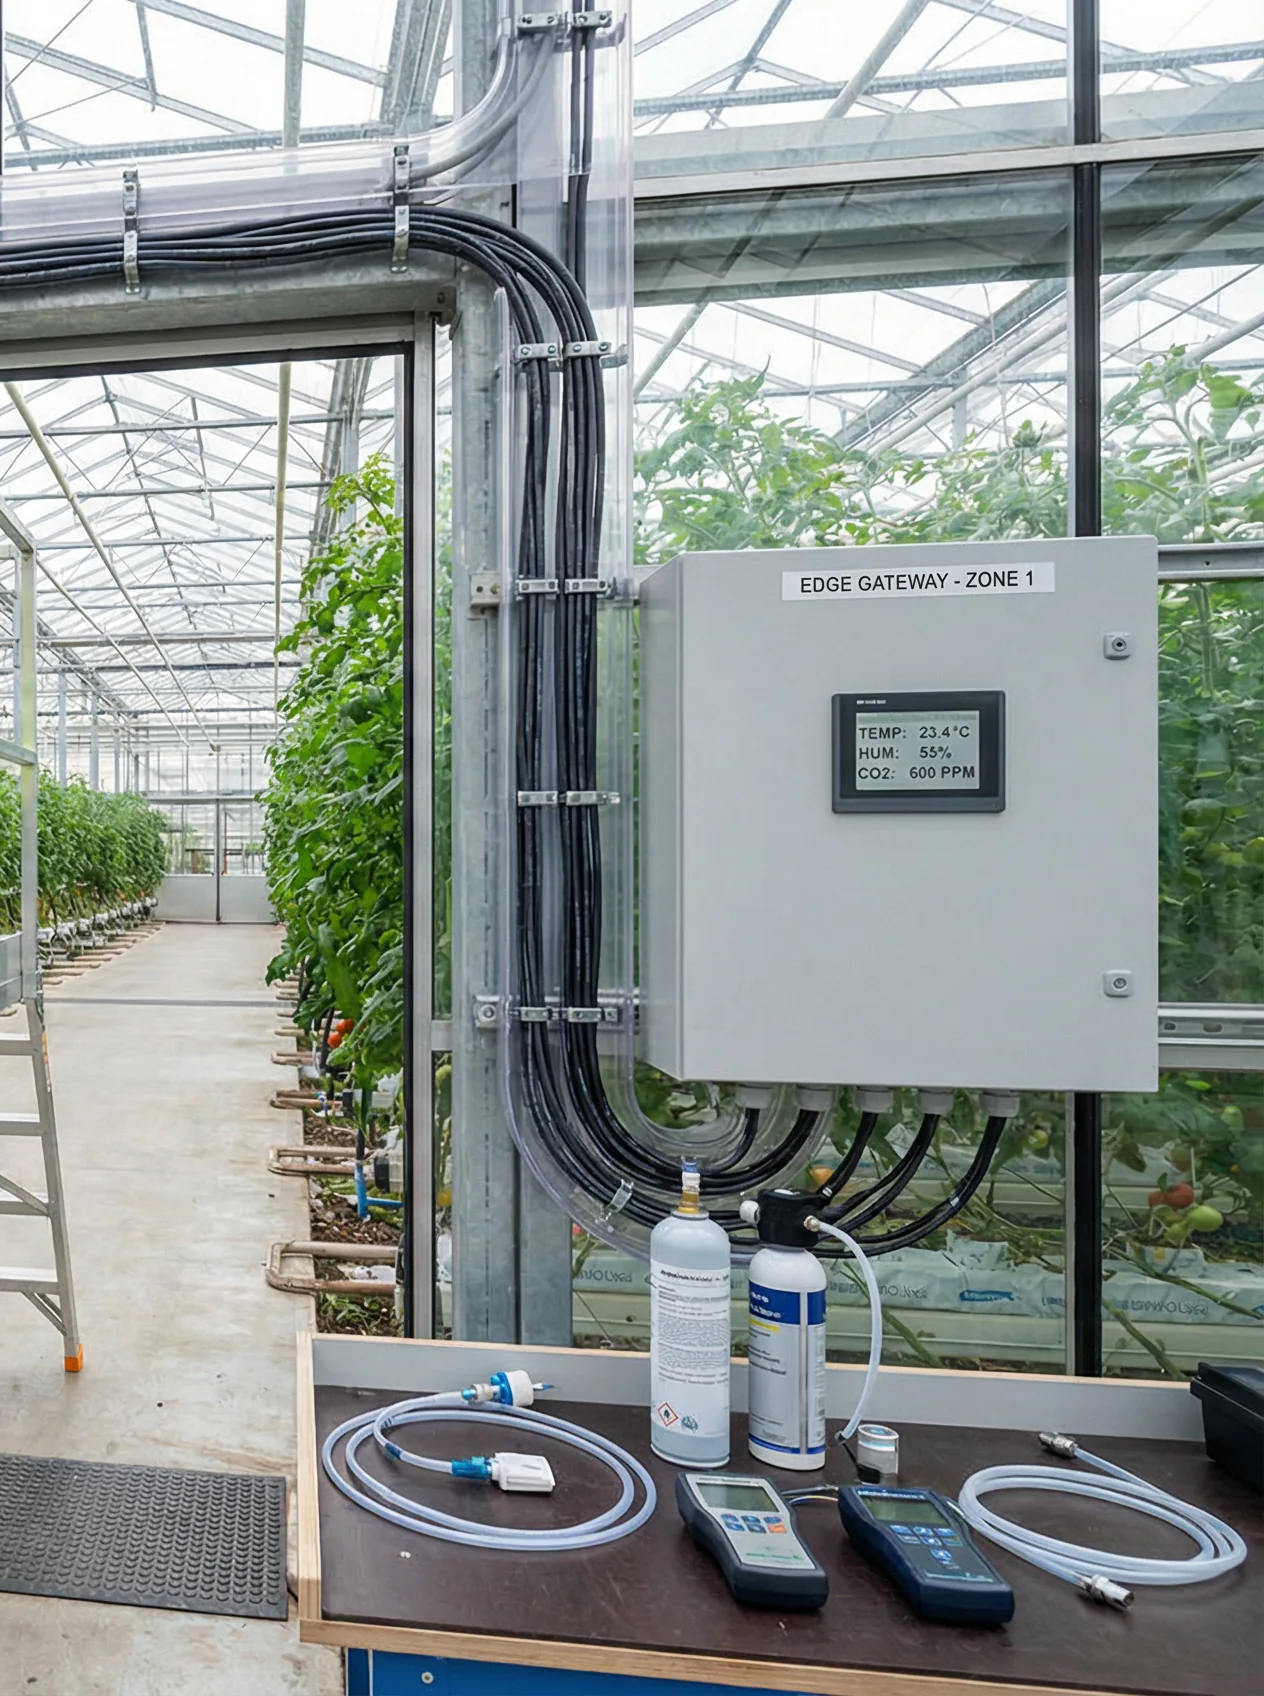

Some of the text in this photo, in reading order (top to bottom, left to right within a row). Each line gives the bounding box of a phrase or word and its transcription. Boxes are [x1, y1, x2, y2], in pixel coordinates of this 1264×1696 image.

[800, 576, 852, 593] EDGE
[857, 572, 949, 591] GATEWAY
[965, 570, 1019, 588] ZONE
[1025, 570, 1034, 586] 1
[858, 726, 907, 739] TEMP:
[858, 746, 952, 760] HUM: 55%
[858, 766, 975, 780] CO2: 600 PPM
